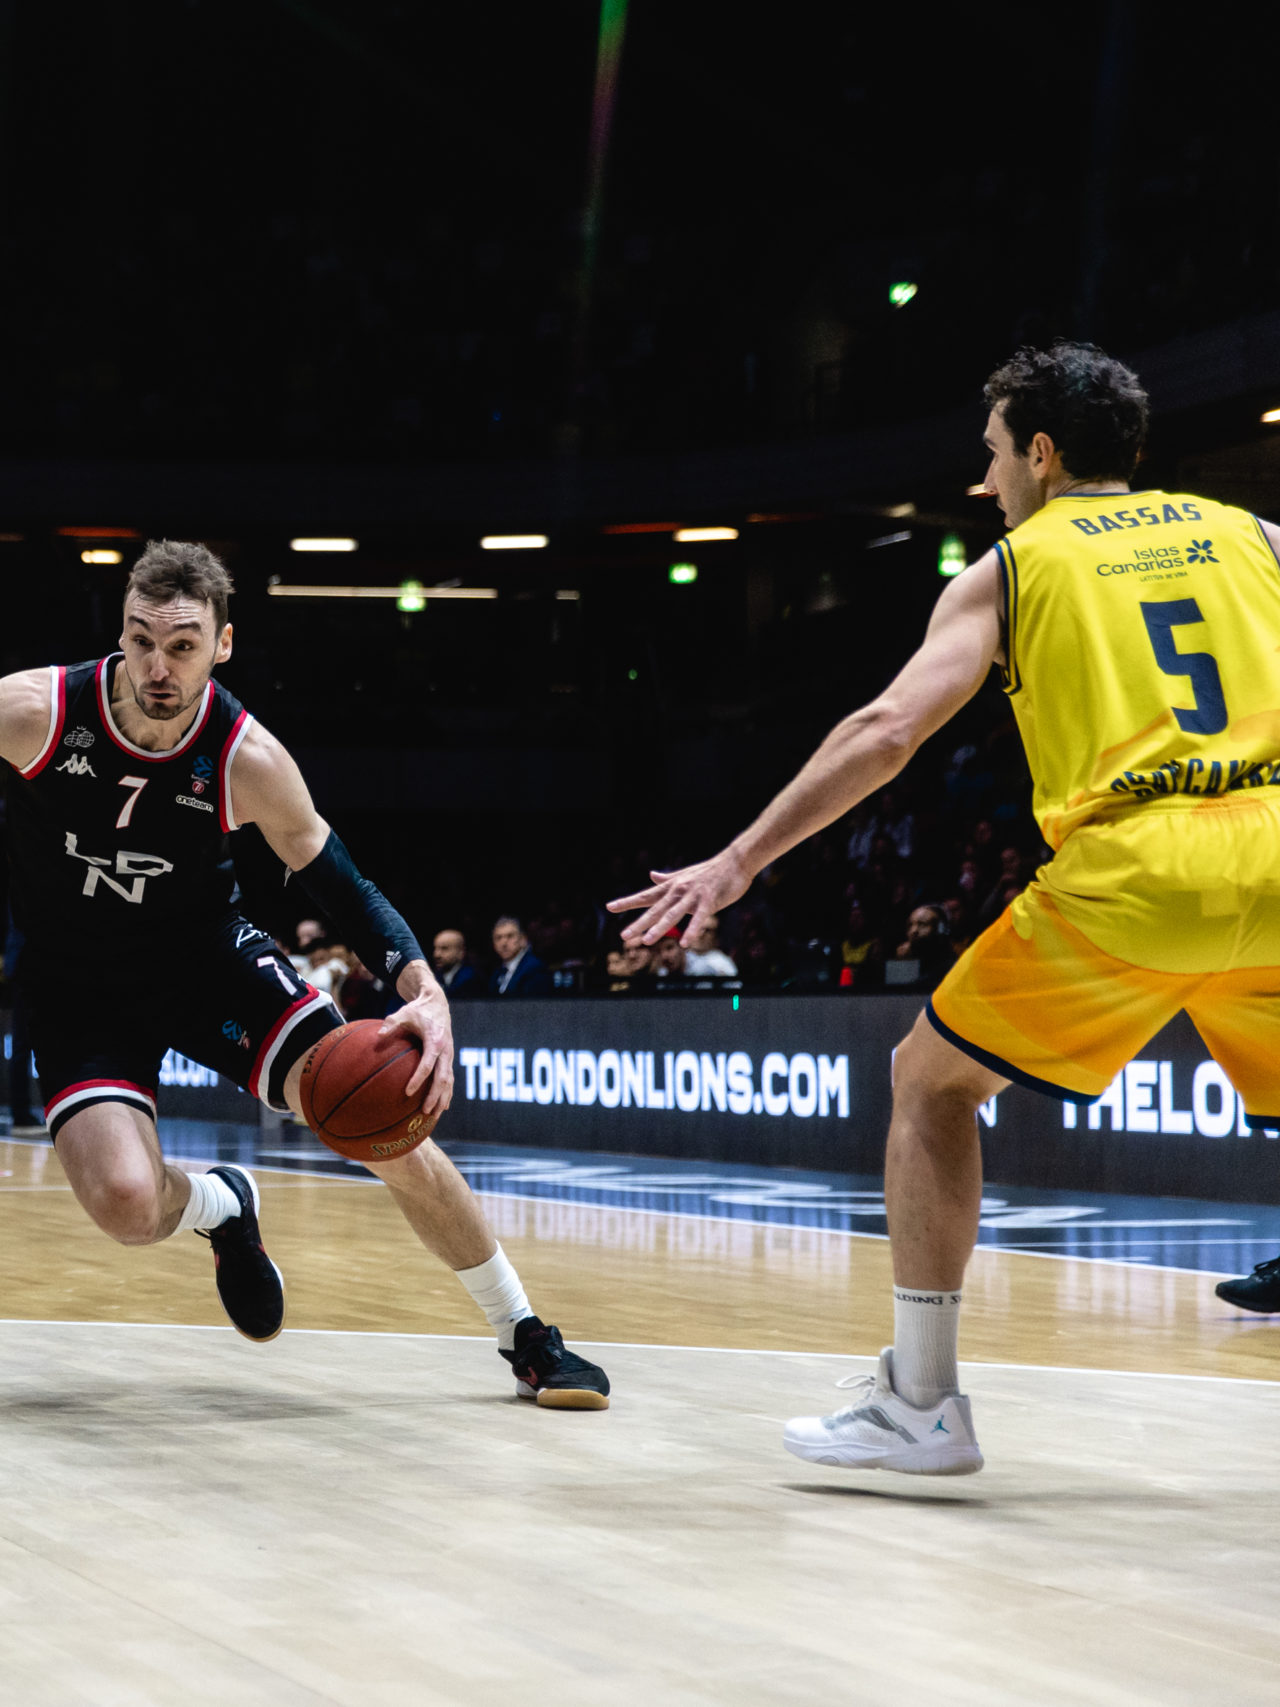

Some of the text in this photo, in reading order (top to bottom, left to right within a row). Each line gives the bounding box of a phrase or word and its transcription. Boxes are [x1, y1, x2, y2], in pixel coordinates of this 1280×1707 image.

[1070, 503, 1203, 536] BASSAS
[1096, 557, 1185, 577] Canarias
[1133, 546, 1180, 560] Islas
[1138, 597, 1229, 736] 5
[116, 775, 149, 829] 7
[176, 795, 213, 813] oneteam
[257, 956, 297, 996] 7
[460, 1048, 850, 1118] THELONDONLIONS.COM
